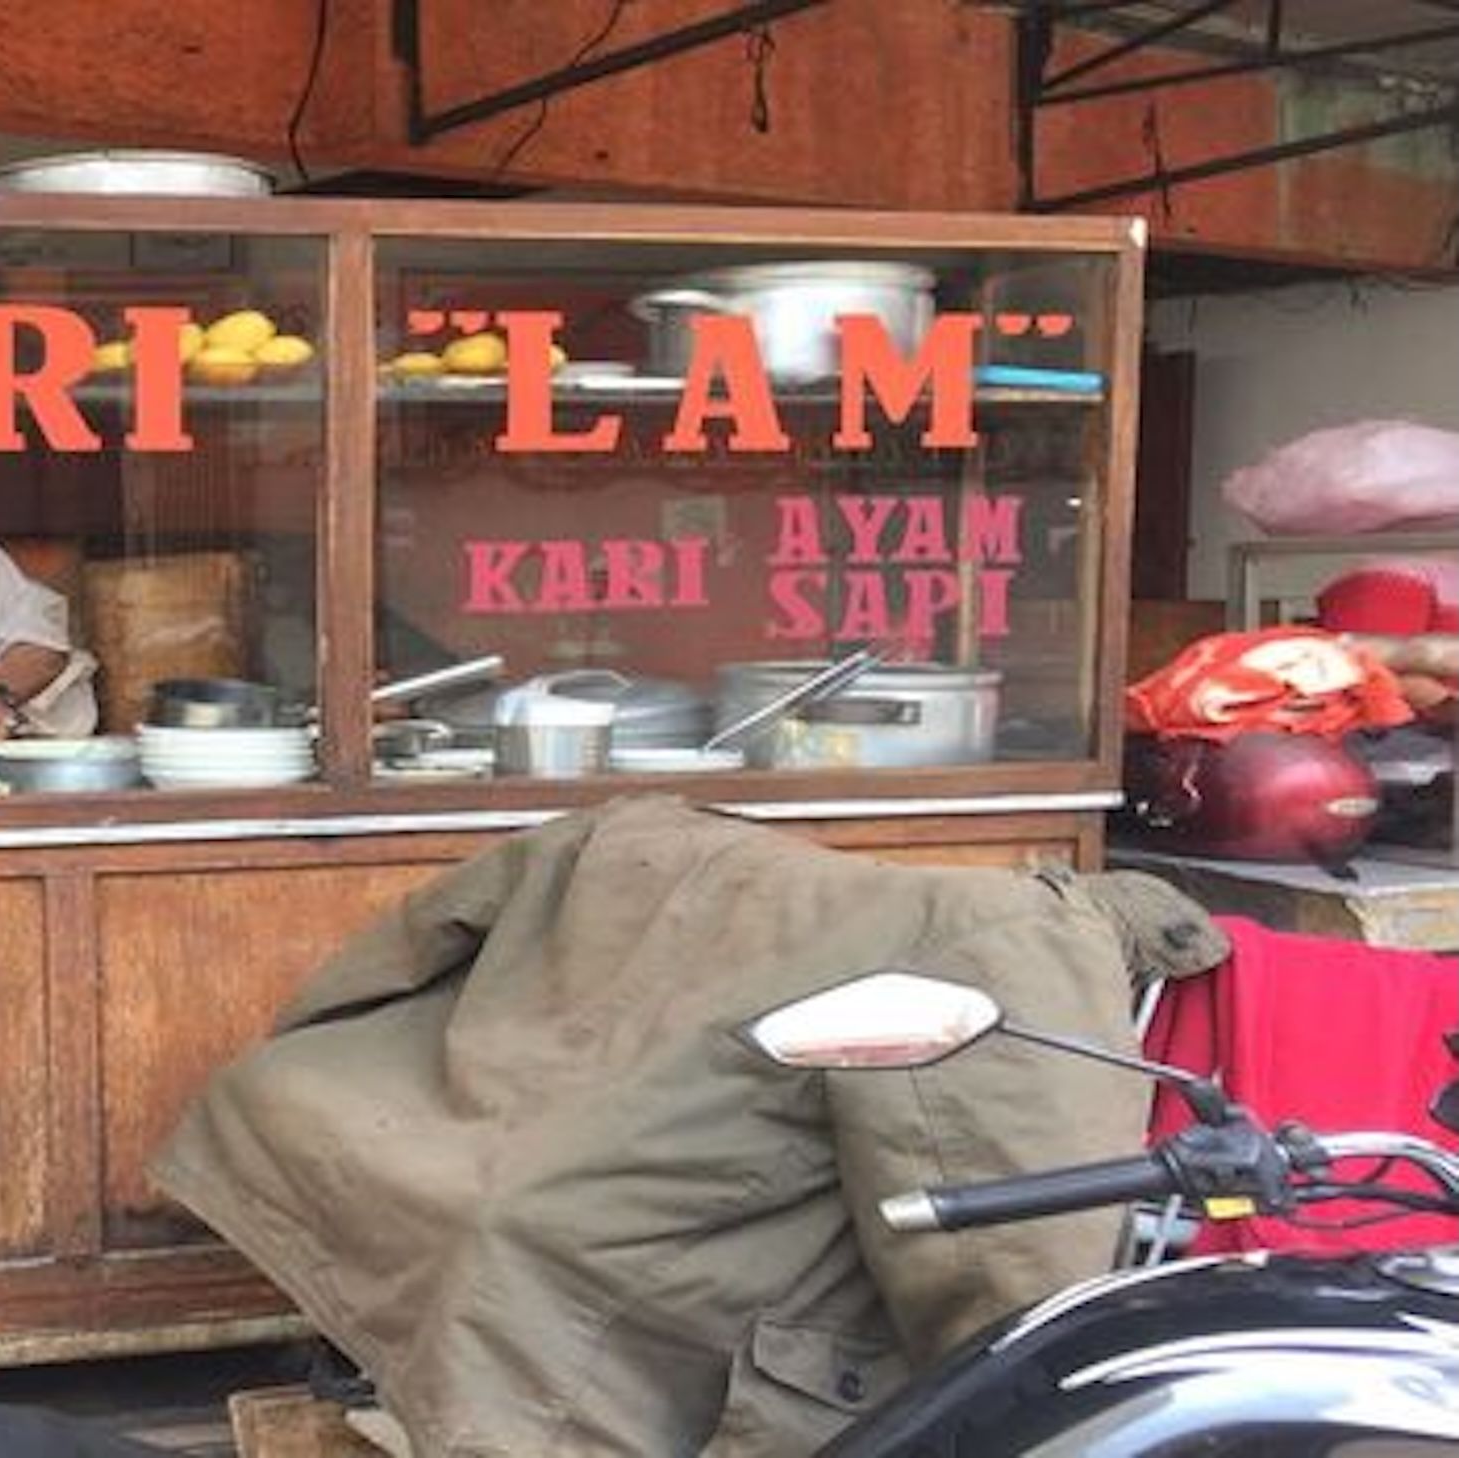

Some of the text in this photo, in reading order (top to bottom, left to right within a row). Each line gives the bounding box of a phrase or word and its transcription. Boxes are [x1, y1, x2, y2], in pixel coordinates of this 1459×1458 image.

[770, 495, 1022, 563] AYAM
[464, 539, 709, 613] KARI
[766, 568, 1015, 640] SAPI
